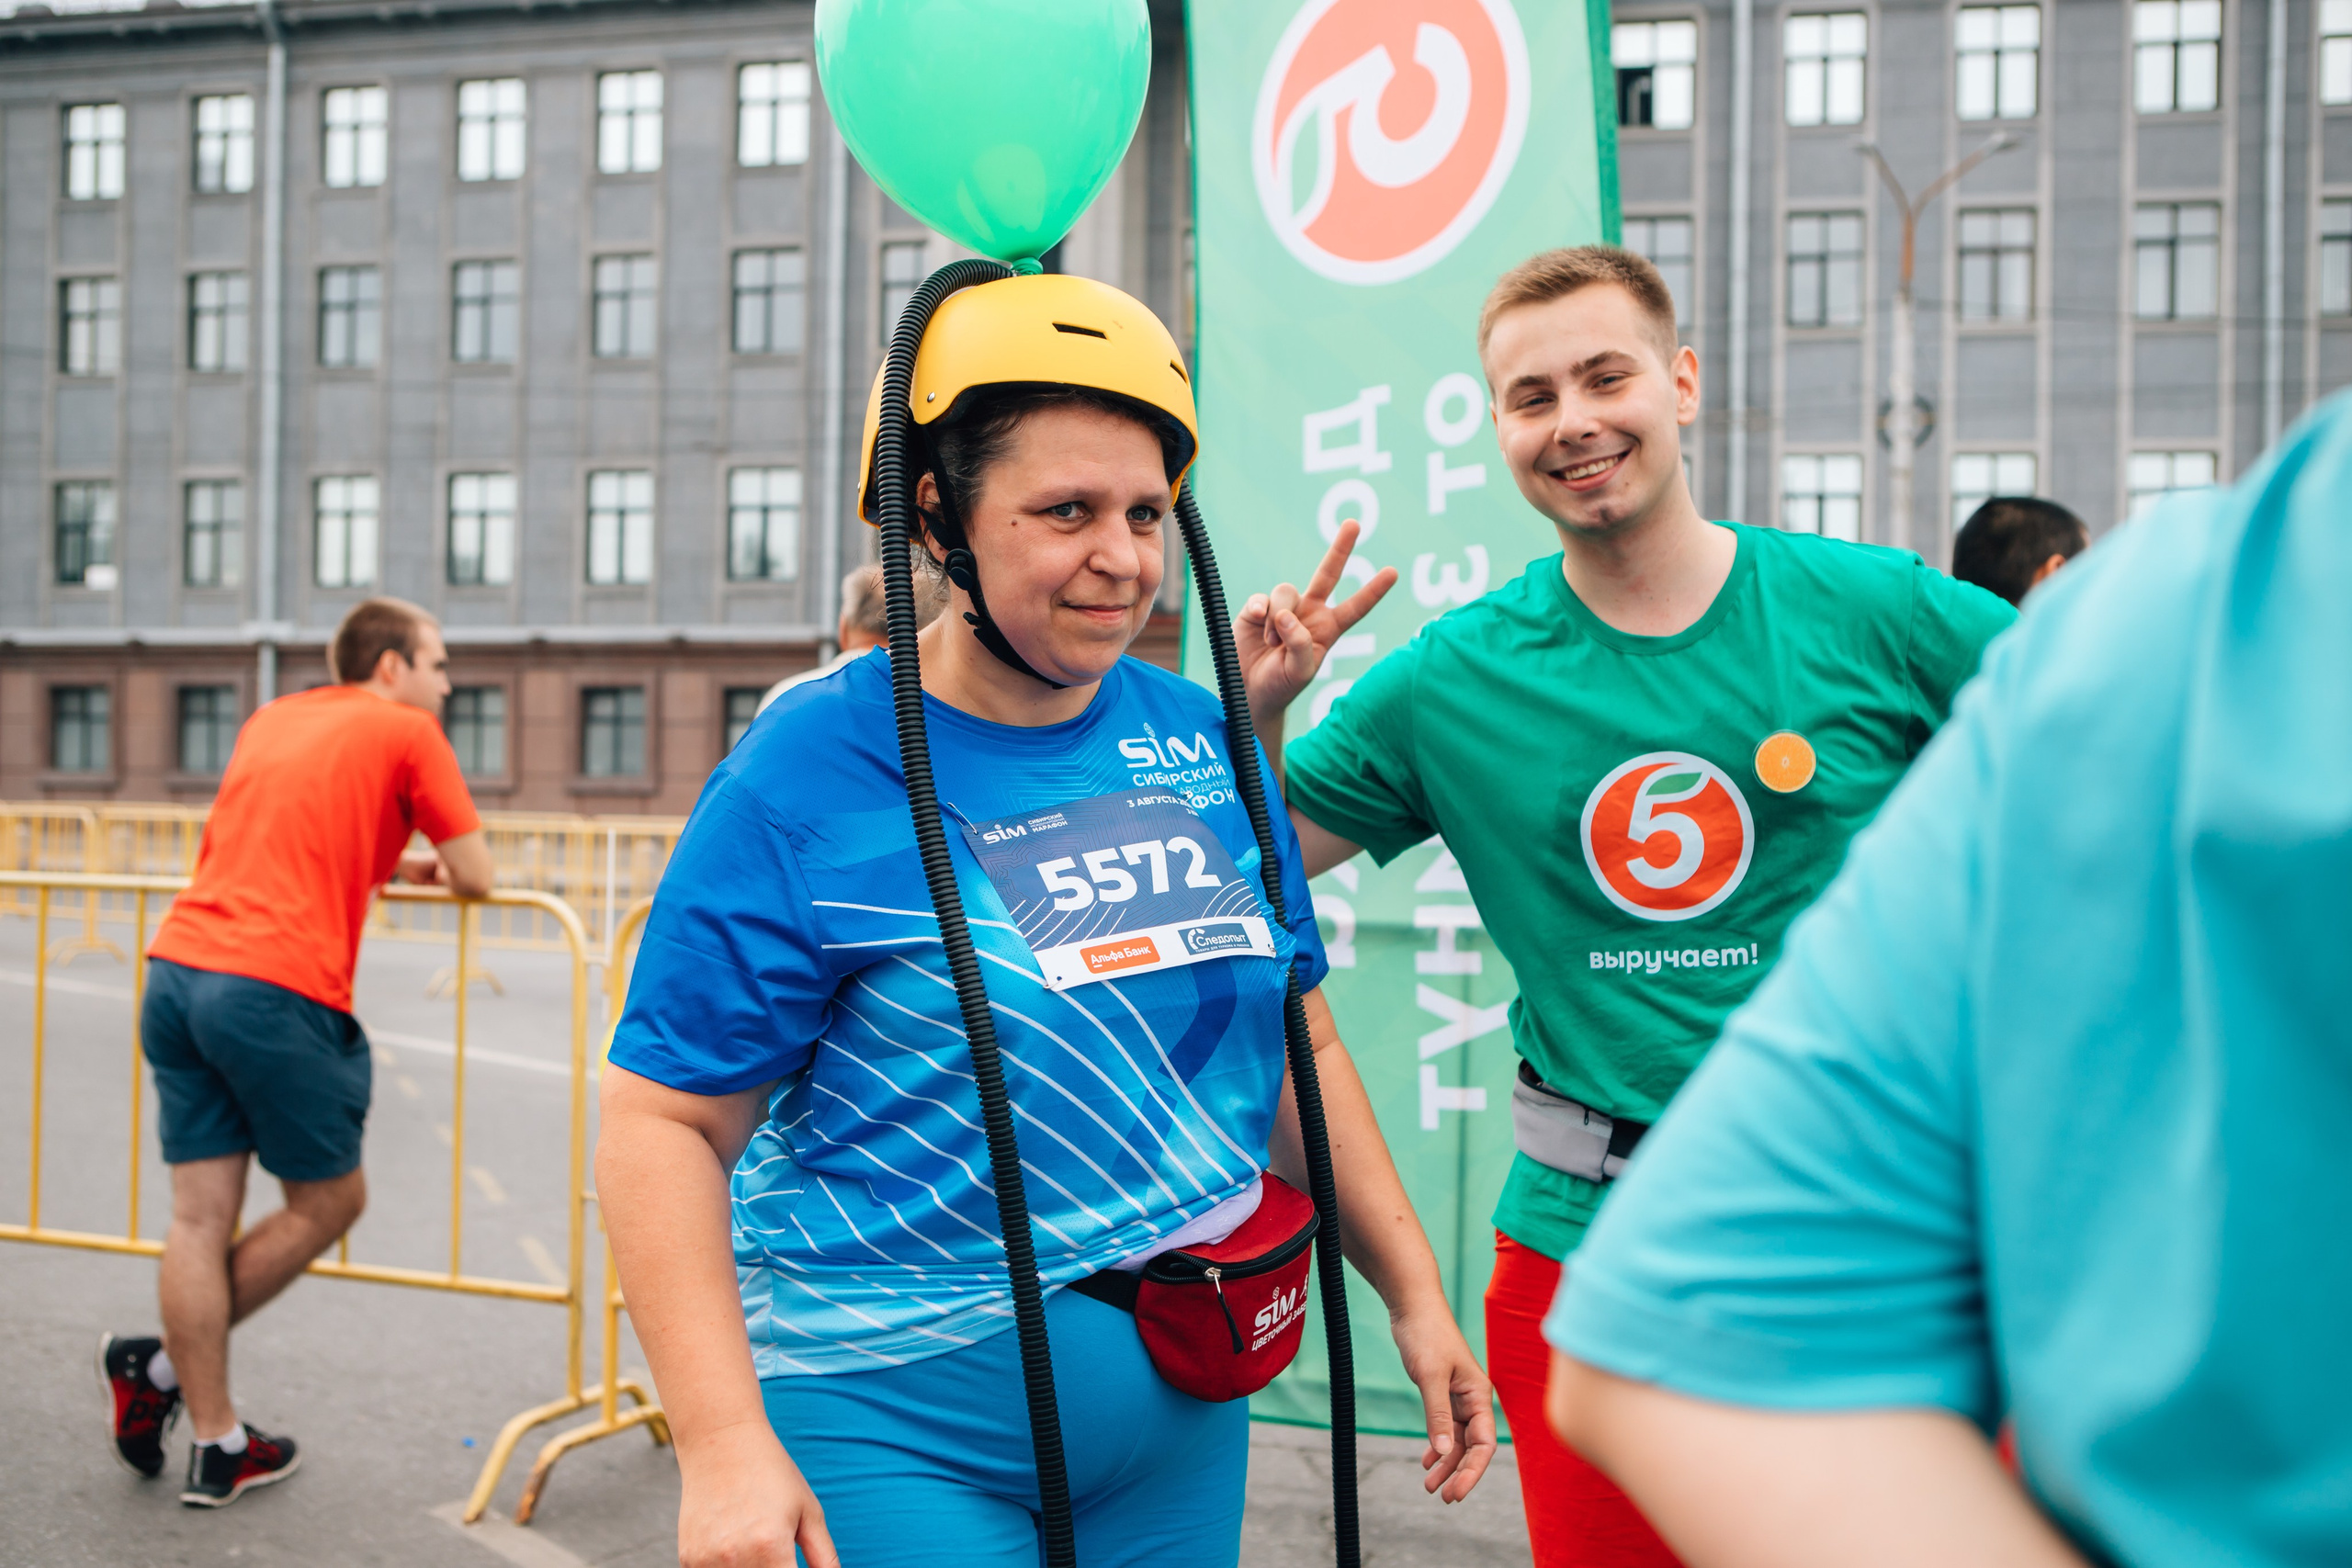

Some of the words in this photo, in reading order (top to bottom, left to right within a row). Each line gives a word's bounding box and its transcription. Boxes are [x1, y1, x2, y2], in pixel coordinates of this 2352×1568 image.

[1136, 795, 1179, 807] АВГУСТА
[1028, 812, 1063, 825] СИБИРСКИЙ
[1032, 820, 1068, 833] МАРАФОН
[1625, 764, 1713, 890] 5
[1035, 836, 1223, 911] 5572
[1195, 934, 1247, 947] Следопыт
[1091, 950, 1125, 964] Альфа
[1124, 946, 1151, 957] Банк
[1589, 942, 1758, 975] выручает!
